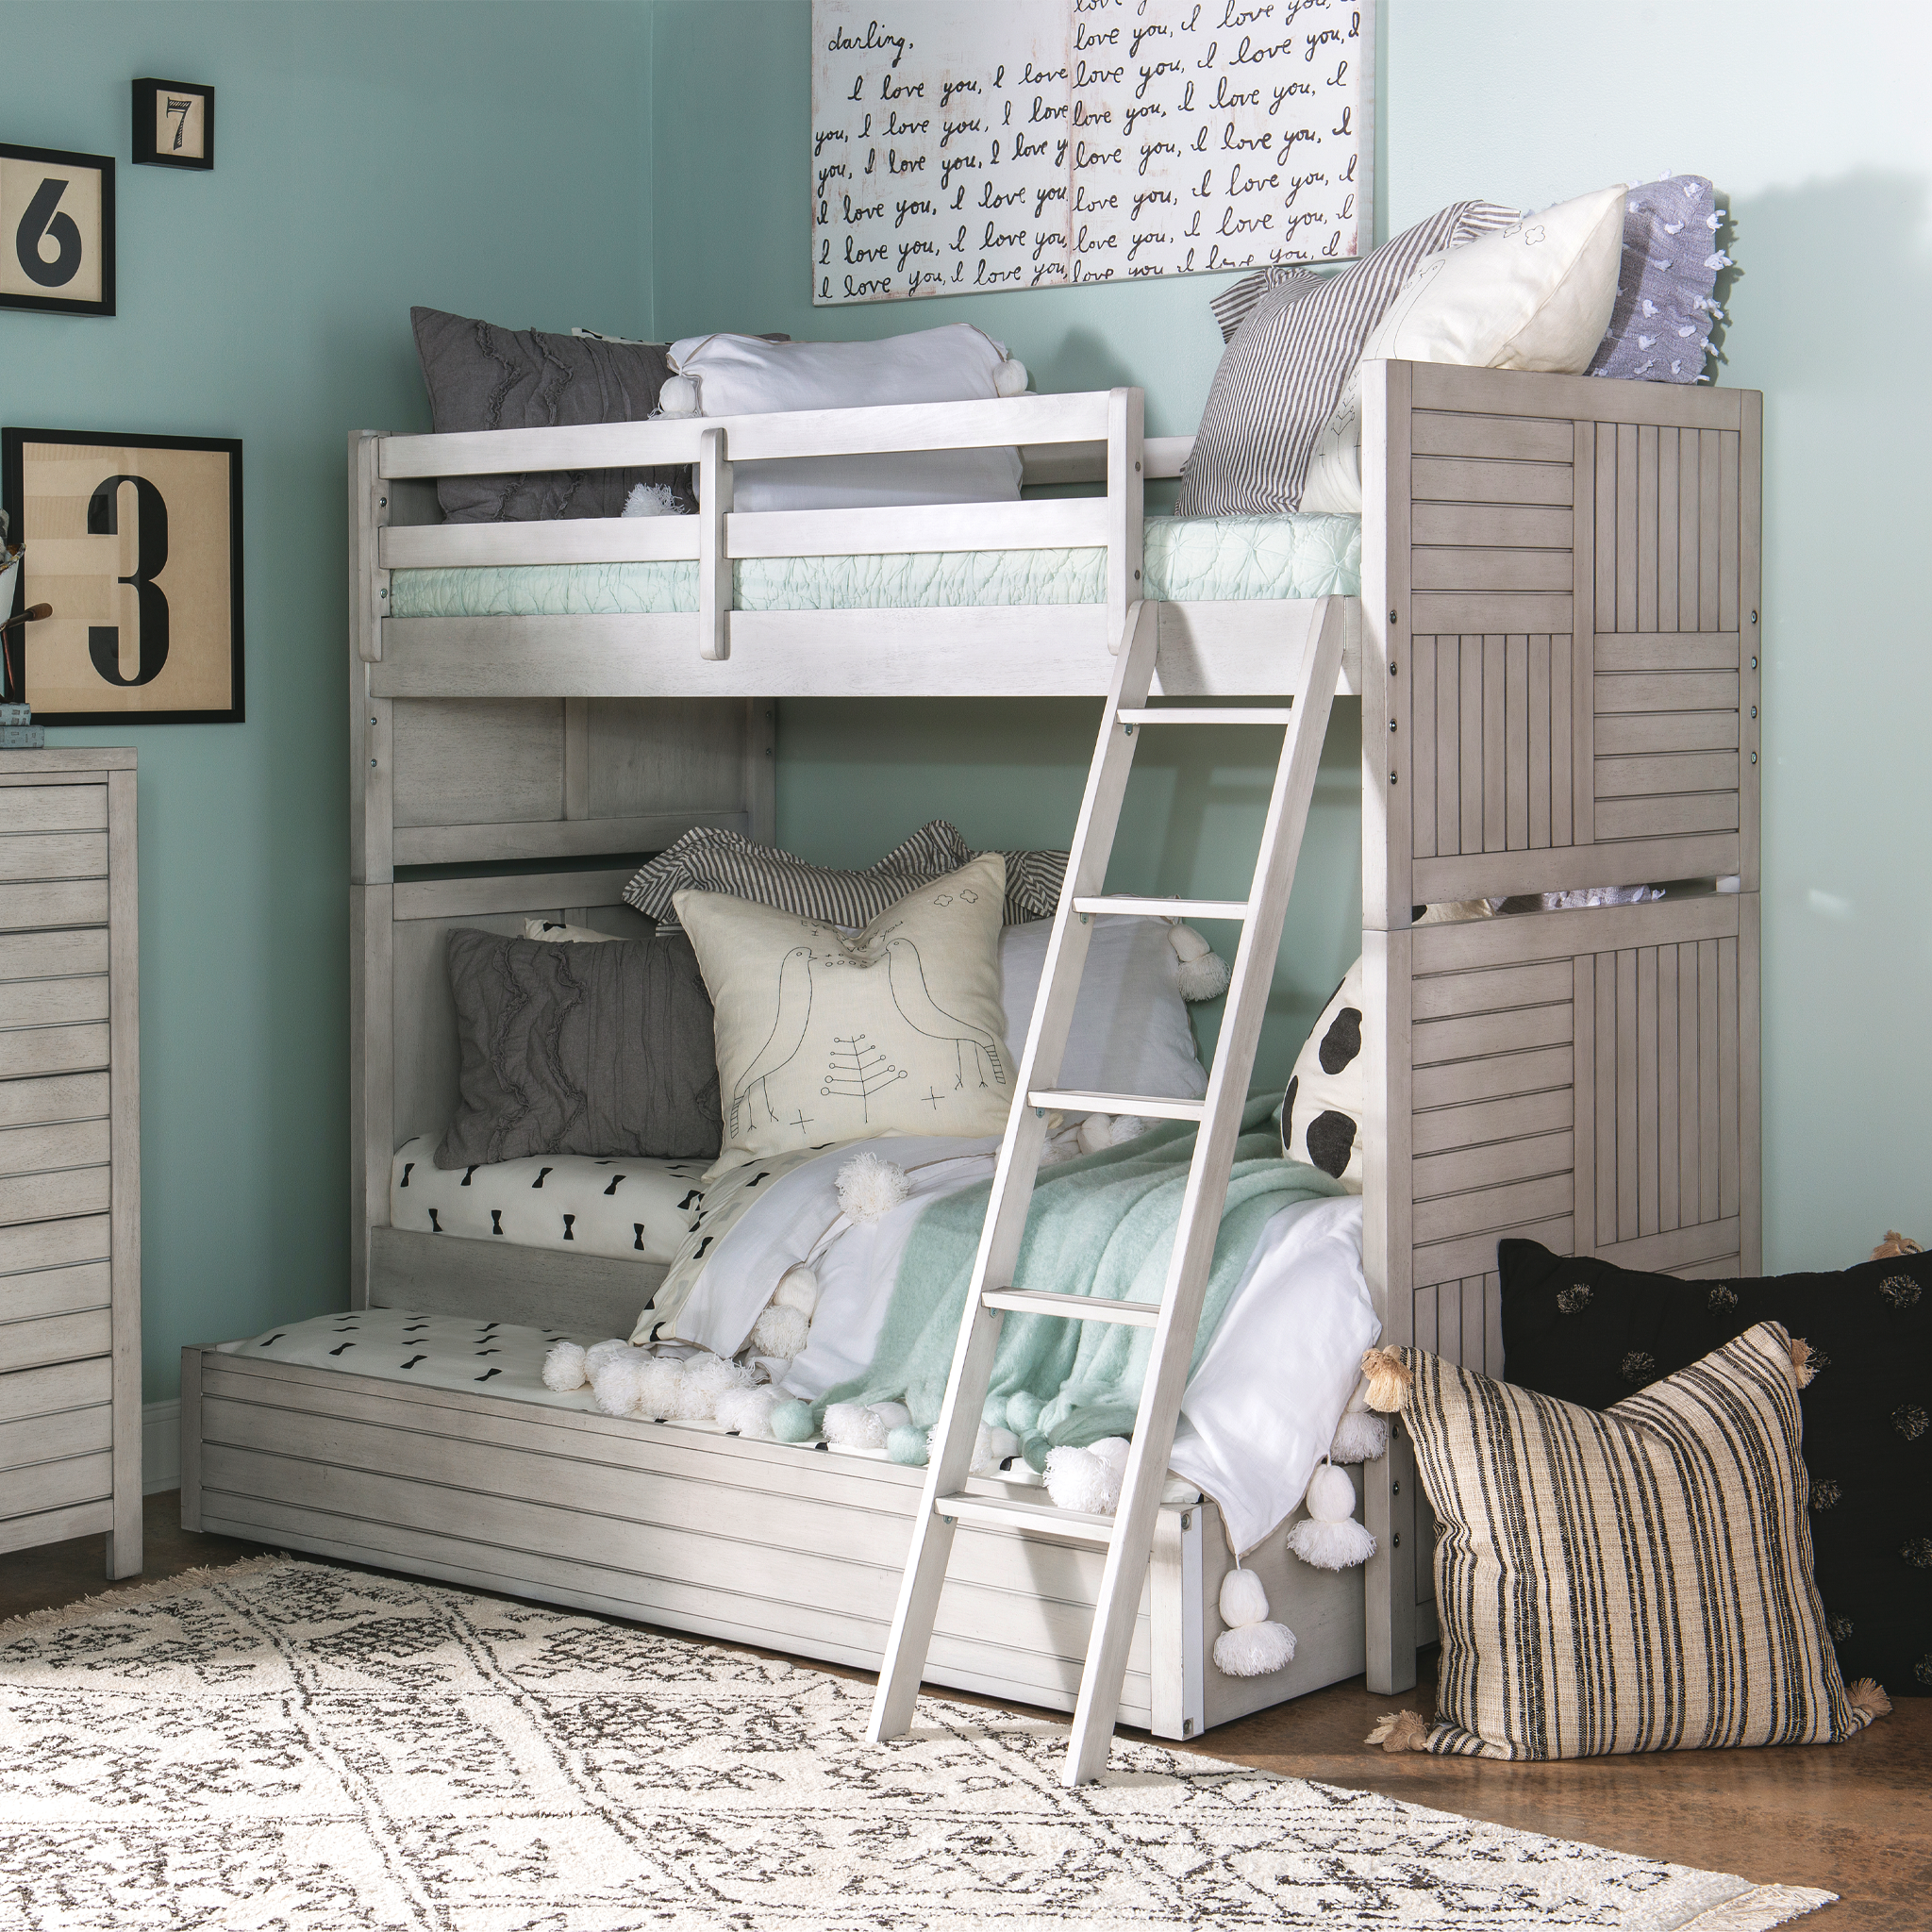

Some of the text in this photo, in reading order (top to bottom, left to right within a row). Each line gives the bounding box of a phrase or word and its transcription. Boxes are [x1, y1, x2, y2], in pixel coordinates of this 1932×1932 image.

[828, 21, 913, 68] darling,
[1074, 24, 1119, 50] love
[1129, 25, 1173, 58] you,
[1217, 0, 1274, 28] love
[880, 75, 924, 100] love
[941, 81, 981, 108] you,
[1019, 63, 1068, 85] love
[1073, 60, 1124, 89] love
[1136, 60, 1184, 99] you,
[1229, 36, 1291, 65] love
[1306, 30, 1343, 61] you,
[167, 97, 192, 150] 7
[815, 130, 848, 157] you,
[882, 111, 929, 136] love
[941, 119, 988, 147] you,
[1028, 96, 1068, 123] love
[1073, 101, 1111, 126] love
[1124, 104, 1166, 136] you,
[1209, 76, 1259, 108] love
[1269, 83, 1315, 115] you,
[818, 164, 852, 198] you,
[889, 149, 925, 174] love
[941, 156, 982, 190] you,
[1012, 132, 1047, 160] love
[1074, 142, 1121, 170] love
[1139, 142, 1181, 175] you,
[1221, 123, 1272, 150] love
[1277, 130, 1321, 166] you,
[843, 194, 884, 224] love
[895, 200, 936, 228] you,
[978, 181, 1025, 208] love
[1073, 187, 1118, 211] love
[1131, 192, 1176, 221] you,
[1225, 164, 1279, 196] love
[1285, 174, 1328, 208] you,
[16, 178, 82, 287] 6
[844, 235, 888, 264] love
[897, 242, 940, 273] you,
[979, 221, 1026, 250] love
[1033, 233, 1067, 260] you,
[1073, 225, 1117, 253] love
[1127, 233, 1173, 260] you,
[1216, 207, 1274, 236] love
[1286, 213, 1326, 242] you,
[844, 275, 891, 297] love
[908, 271, 945, 296] you,
[974, 258, 1021, 285] love
[88, 475, 169, 686] 3
